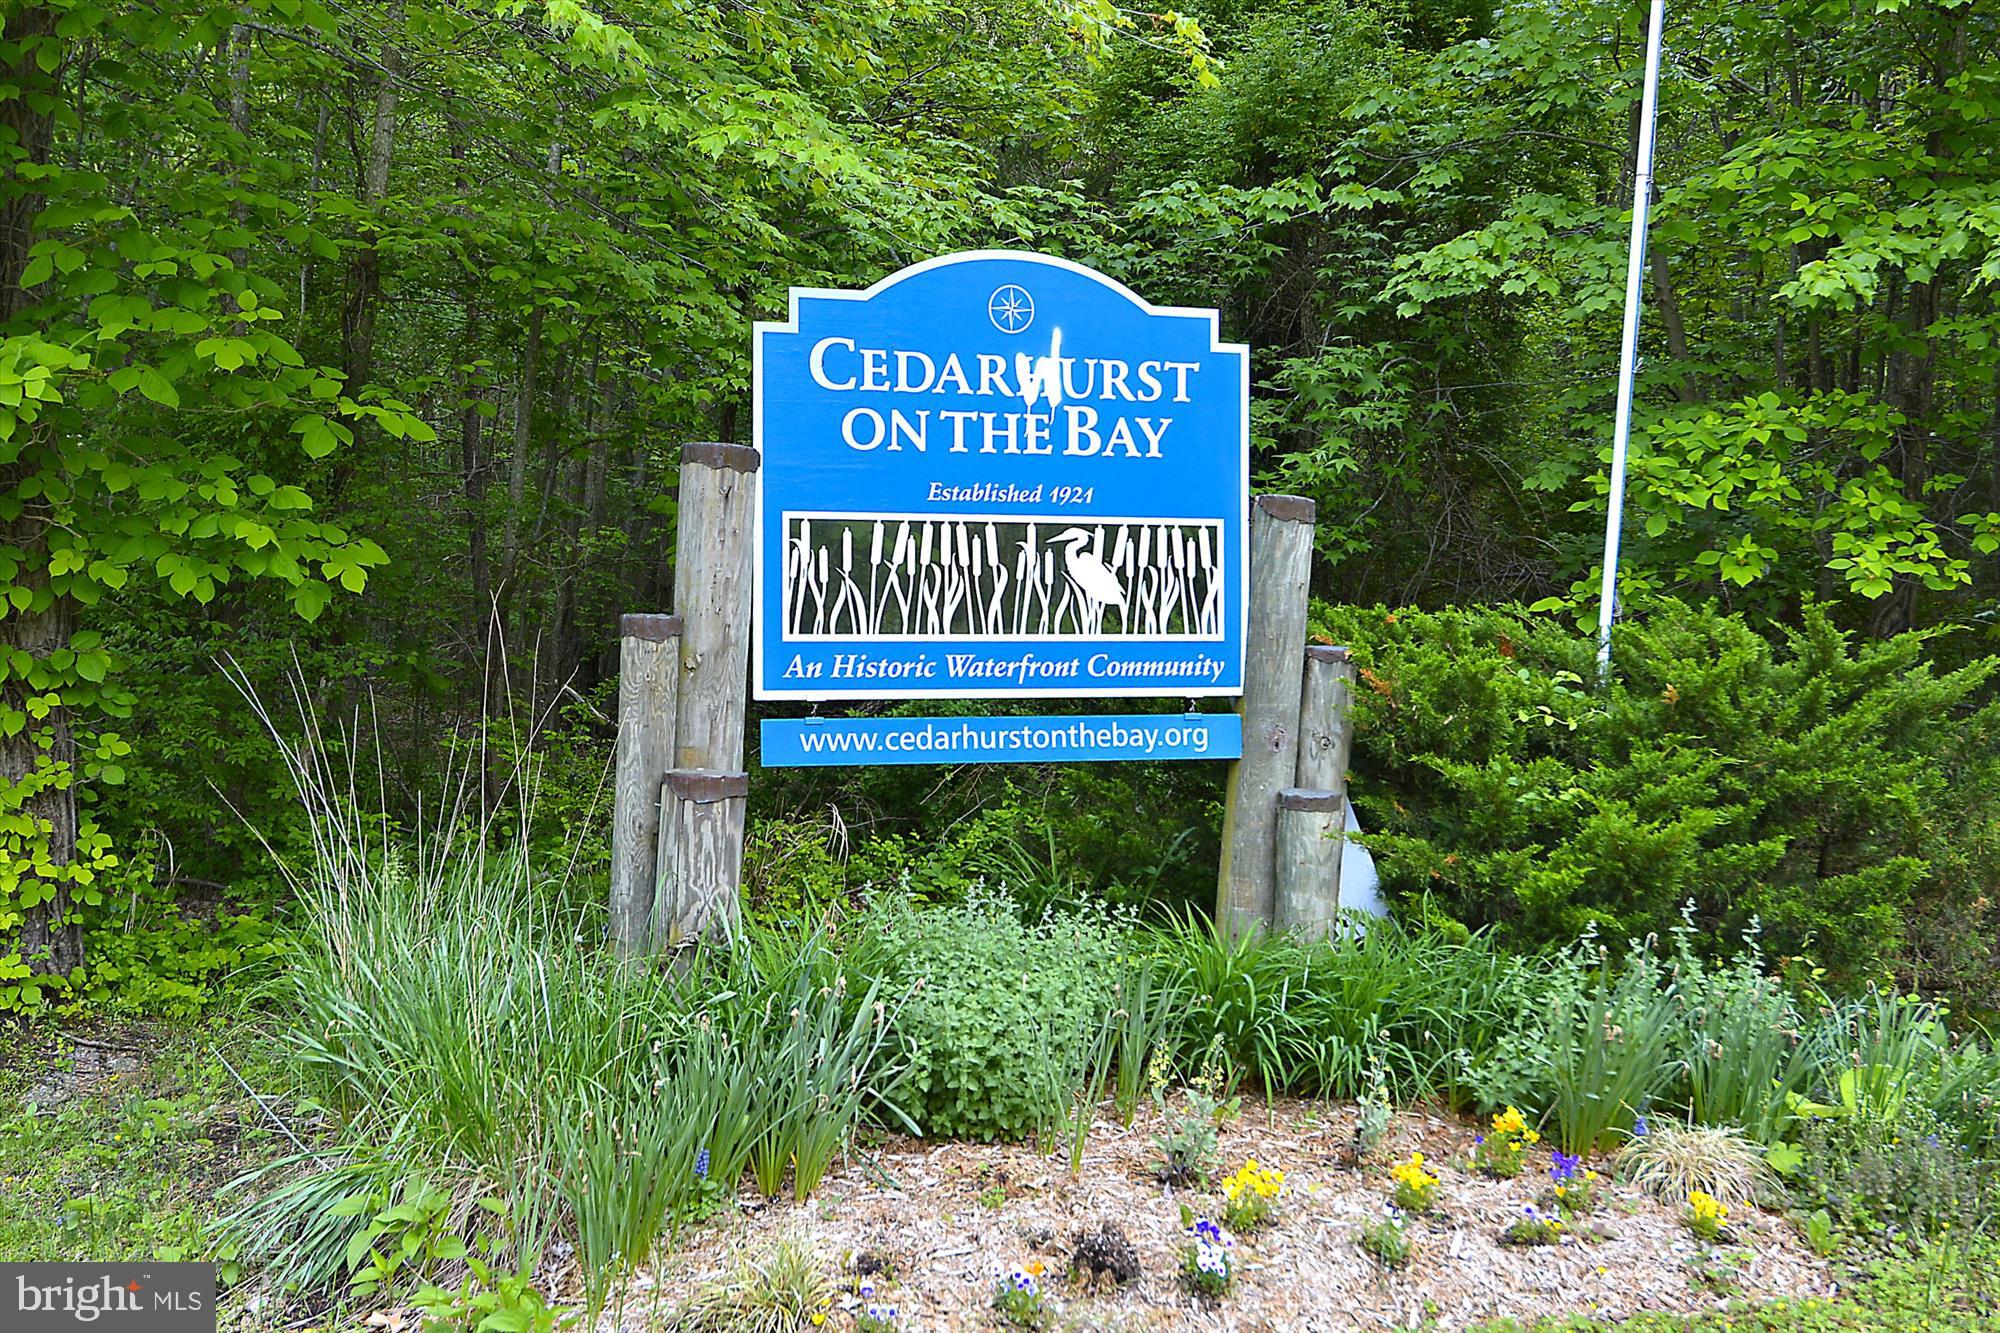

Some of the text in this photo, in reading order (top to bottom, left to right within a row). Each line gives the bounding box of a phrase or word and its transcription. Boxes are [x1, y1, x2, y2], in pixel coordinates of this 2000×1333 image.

[840, 404, 1174, 460] ON THE BAY
[926, 481, 1094, 505] Established 1921
[782, 651, 1226, 686] An Historic Waterfront Community
[799, 720, 1210, 754] www.cedarhurstonthebay.org
